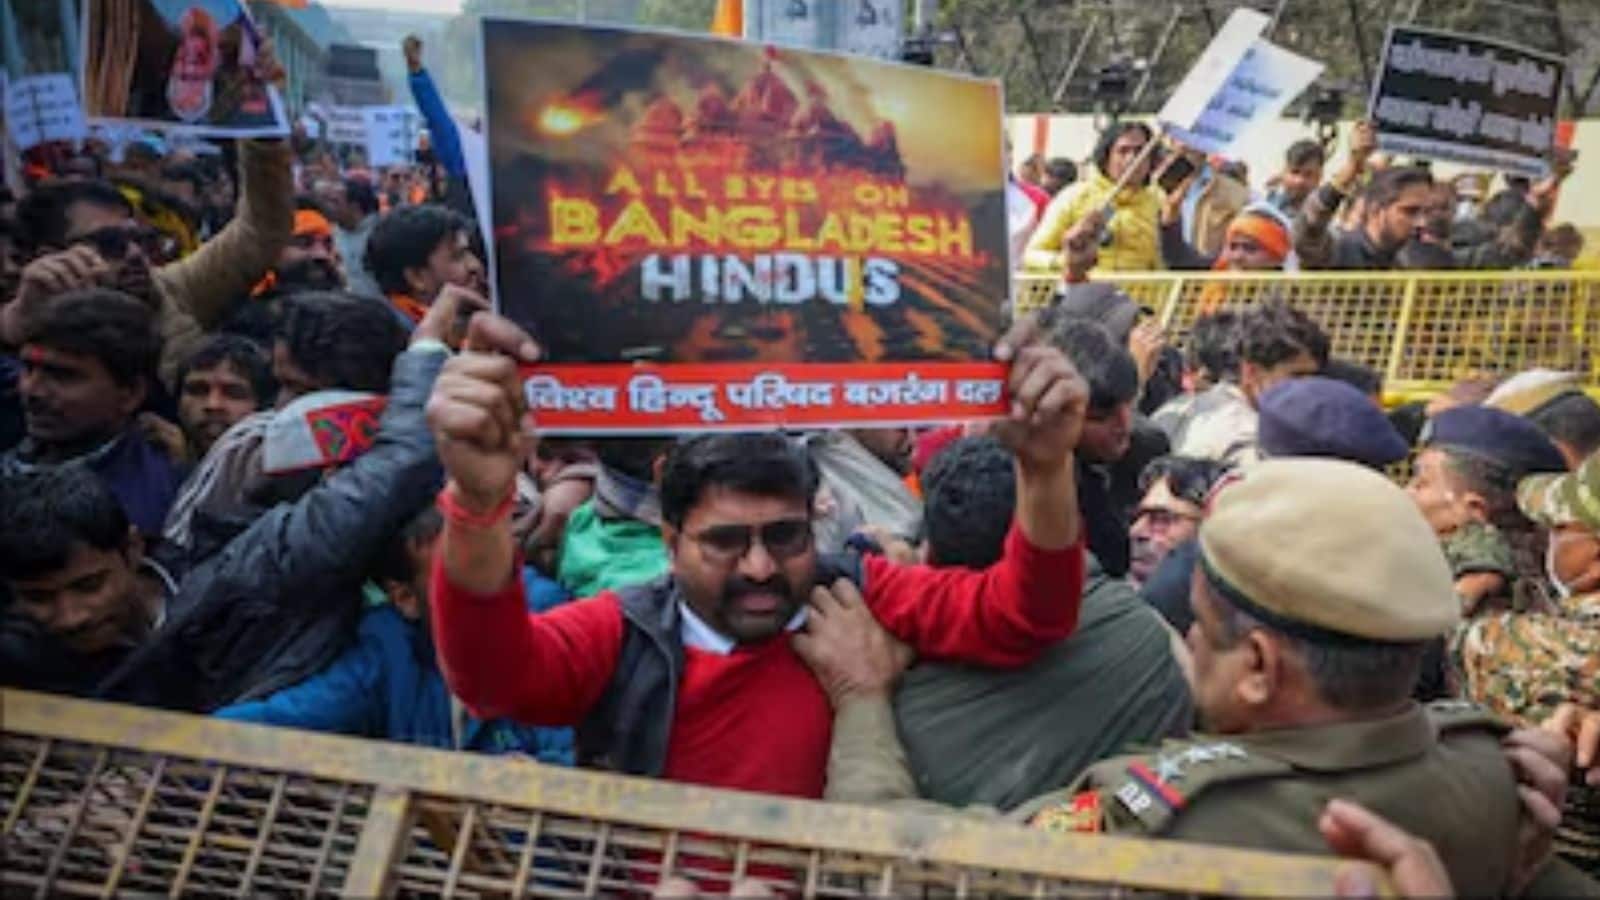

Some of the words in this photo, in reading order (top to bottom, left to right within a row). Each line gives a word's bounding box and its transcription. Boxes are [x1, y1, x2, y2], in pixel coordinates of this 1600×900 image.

[606, 165, 707, 198] ALL
[725, 174, 818, 202] EYES
[854, 182, 908, 207] ON
[547, 196, 973, 257] BANGLADESH
[640, 252, 901, 305] HINDUS
[524, 374, 617, 411] विश्व
[628, 373, 725, 422] हिन्दू
[725, 370, 834, 411] परिषद
[954, 378, 1003, 406] दल
